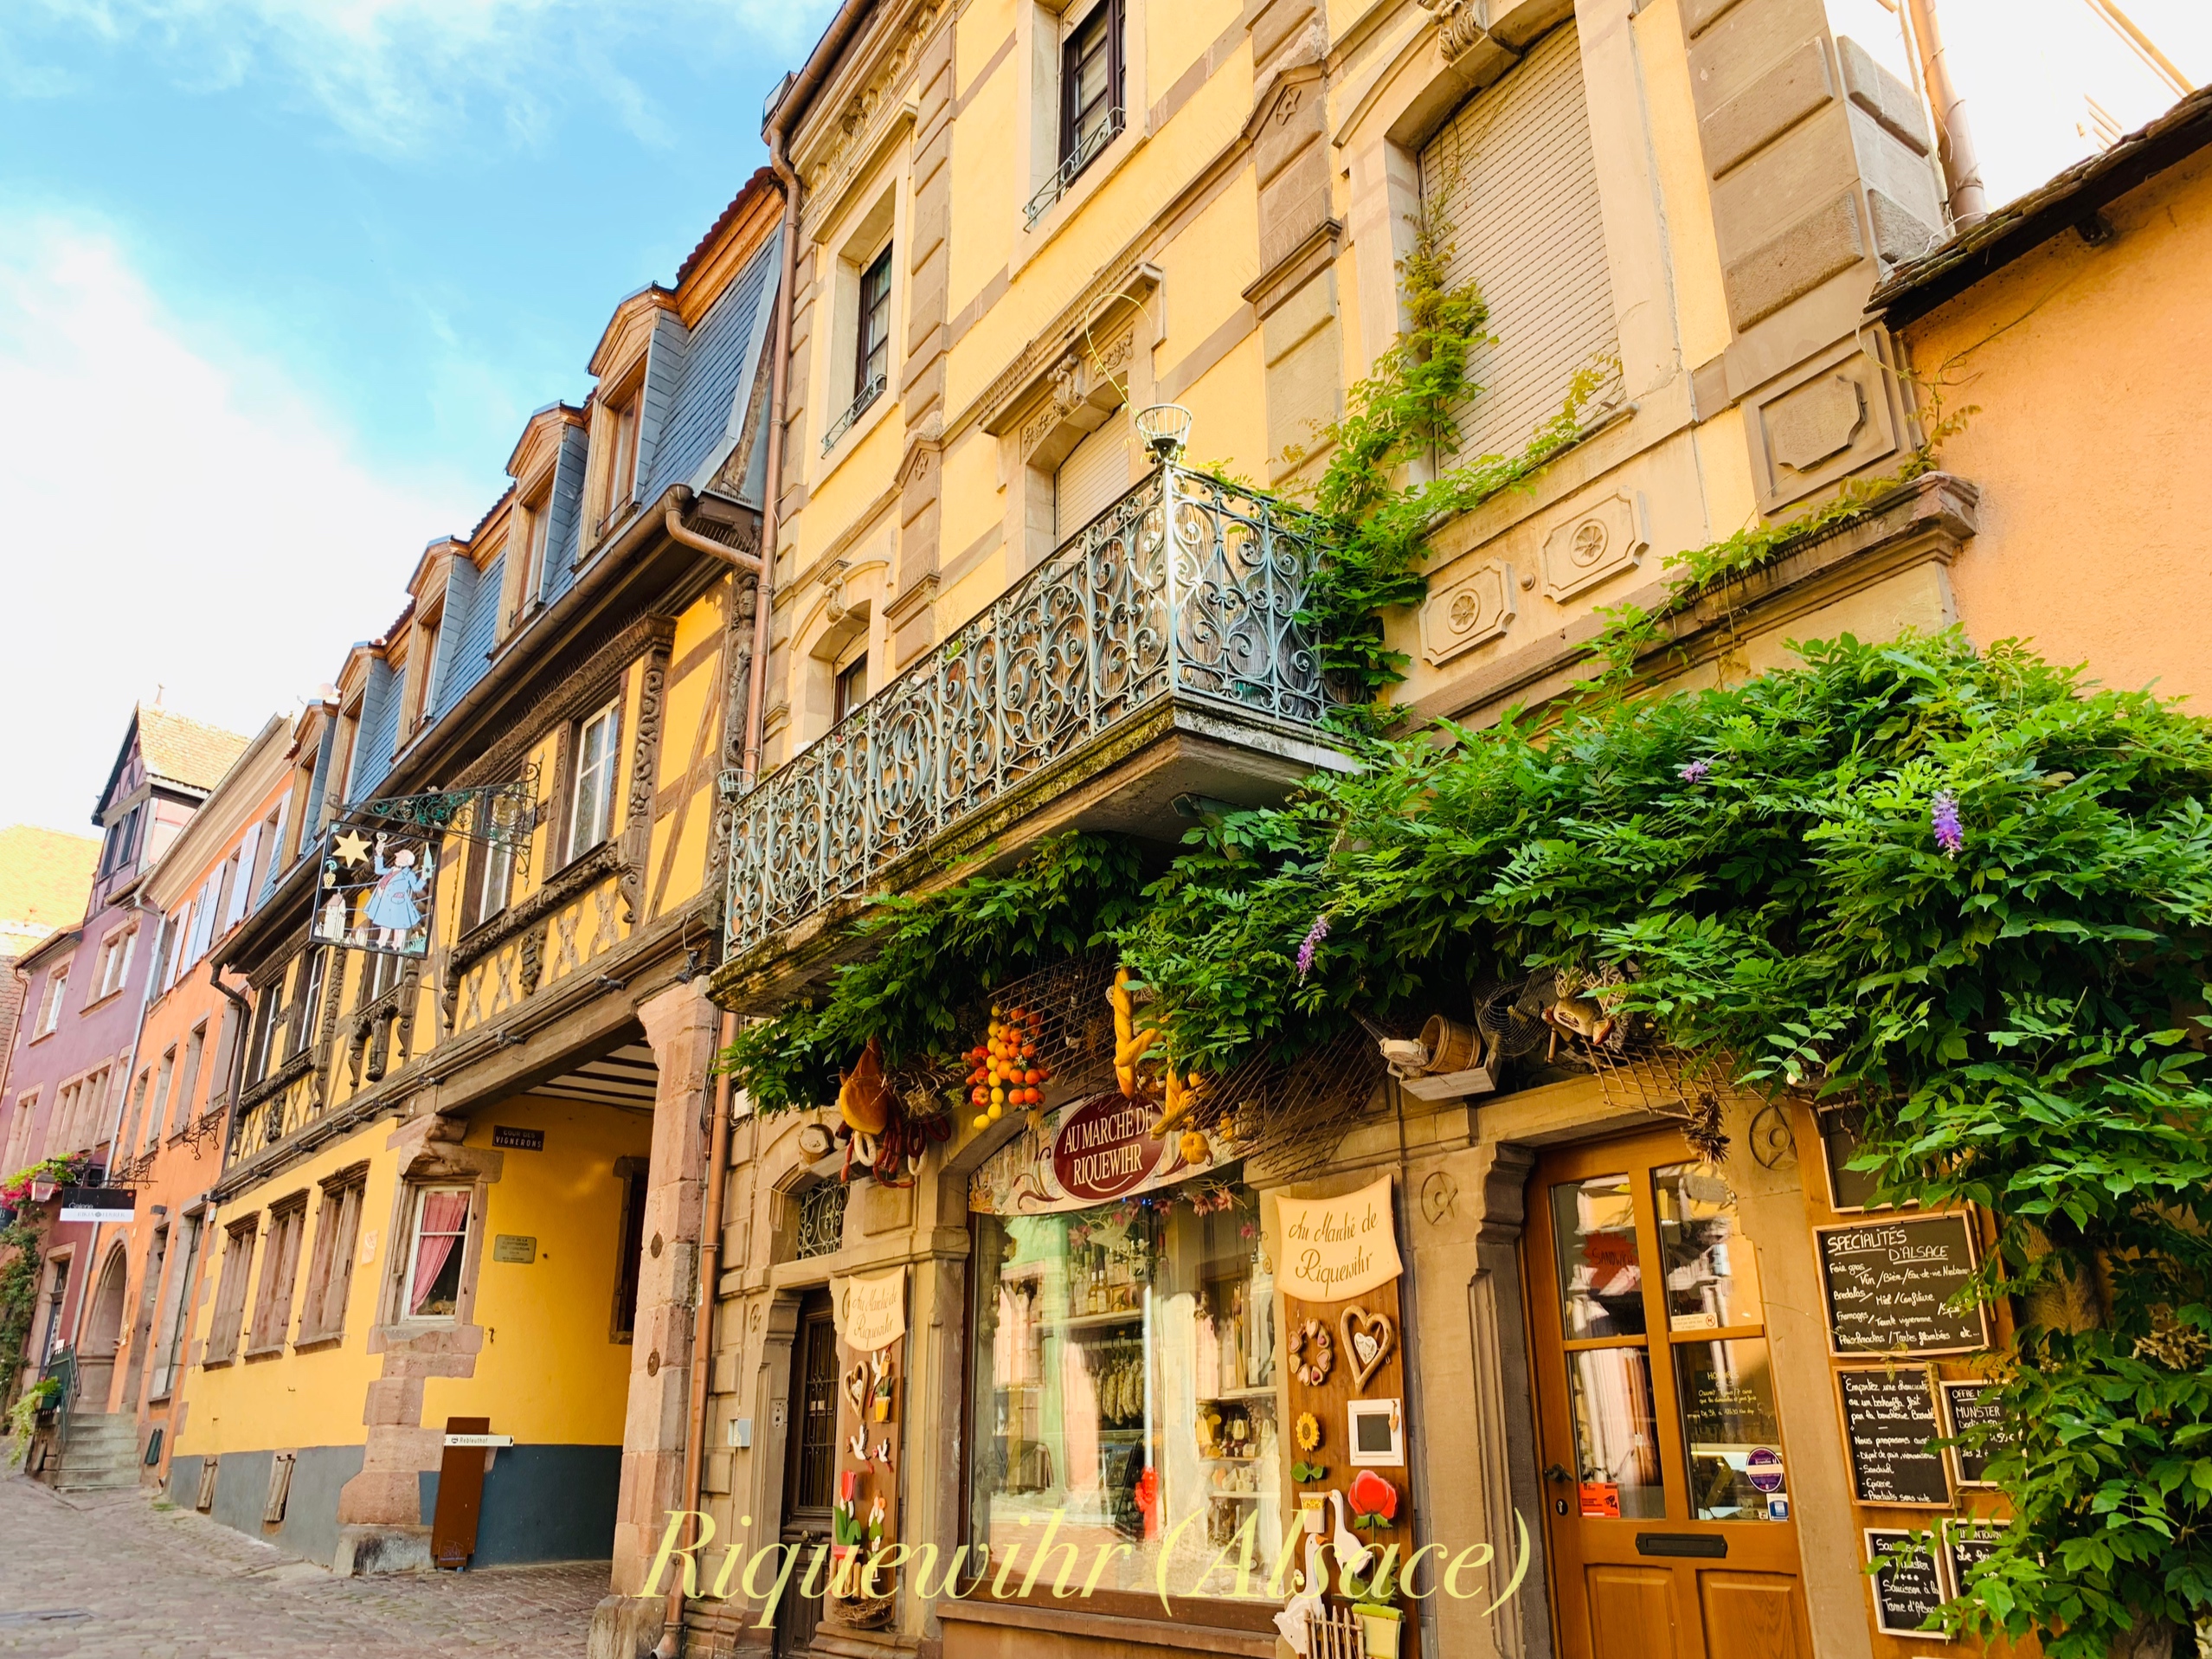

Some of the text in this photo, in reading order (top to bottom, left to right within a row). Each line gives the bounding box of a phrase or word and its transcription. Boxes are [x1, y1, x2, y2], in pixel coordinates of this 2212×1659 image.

[1064, 1101, 1154, 1154] AU MARCHÉ DE
[495, 1135, 542, 1148] VIGNERONS
[1072, 1142, 1143, 1193] RIQUEWIHR
[1288, 1202, 1379, 1243] Au Marché de
[1888, 1244, 1949, 1262] D'ALSACE
[1295, 1244, 1373, 1297] Riquewihr
[853, 1312, 894, 1348] Riquewihr
[1952, 1388, 1975, 1399] OFFRE
[1956, 1405, 2001, 1418] MUNSTER
[1907, 1600, 1937, 1619] d'Alsac
